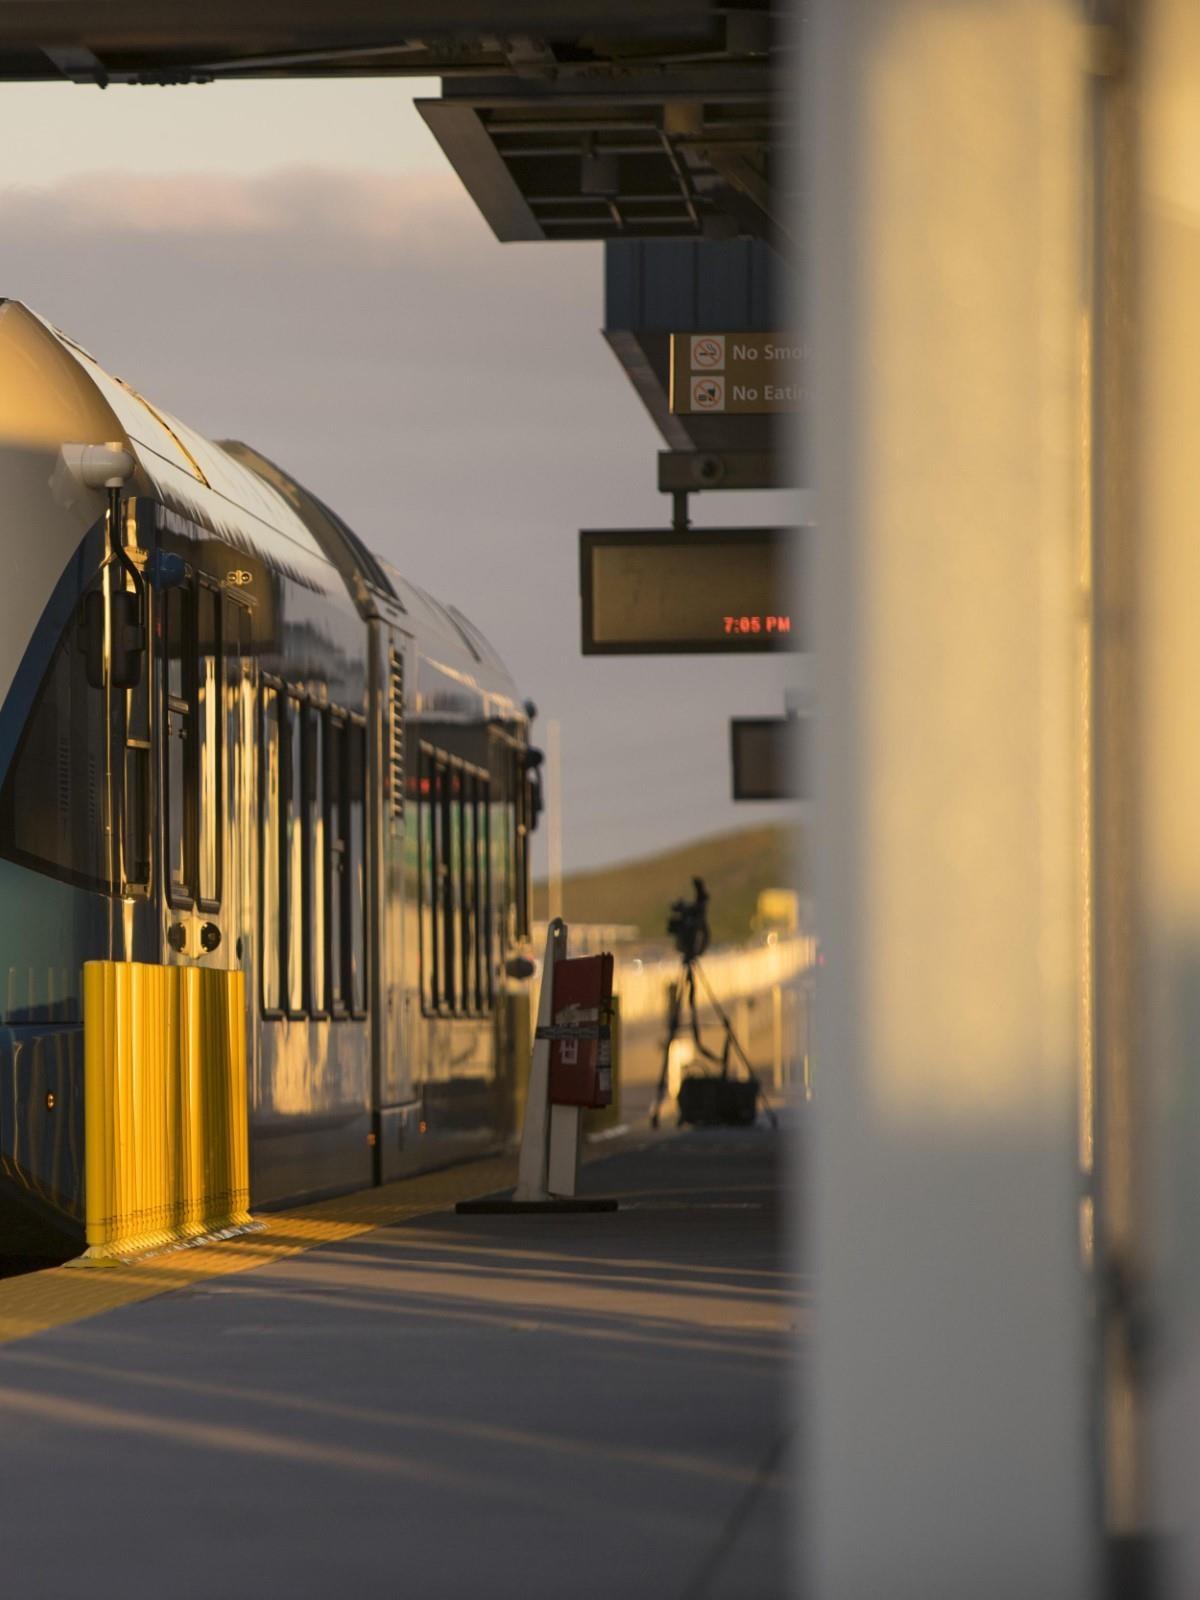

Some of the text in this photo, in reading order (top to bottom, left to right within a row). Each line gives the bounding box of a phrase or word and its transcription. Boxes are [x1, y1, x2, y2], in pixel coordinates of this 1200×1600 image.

[732, 343, 816, 361] No Smok
[732, 383, 811, 401] No Eatin
[723, 616, 791, 634] 7:05 PM
